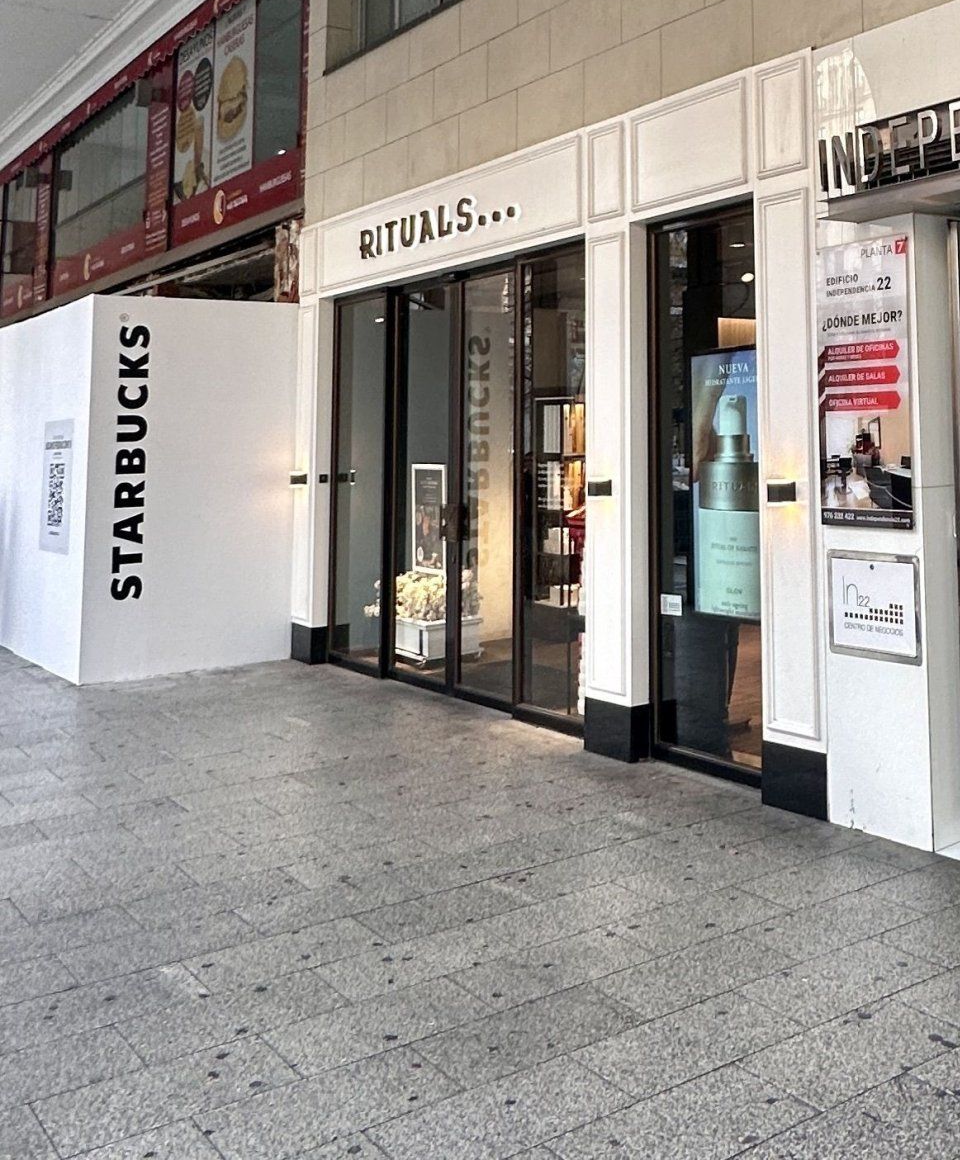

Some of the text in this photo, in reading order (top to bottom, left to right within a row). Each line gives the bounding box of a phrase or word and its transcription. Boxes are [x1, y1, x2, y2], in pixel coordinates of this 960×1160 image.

[861, 245, 892, 259] PLANTA
[826, 273, 859, 287] EDIFICIO
[826, 276, 892, 298] INDEPENDENCIA 22
[822, 314, 860, 332] ¿DÓNDE
[861, 310, 903, 326] MEJOR?
[828, 343, 894, 355] ALQUILER DE OFICINAS
[718, 363, 748, 374] NUEVA
[828, 371, 886, 382] ALQUILER DE SALAS
[828, 397, 879, 407] OFICINA VIRTUAL
[110, 324, 151, 601] STARBUCKS
[844, 622, 904, 637] CENTRO DE NEGOCIOS
